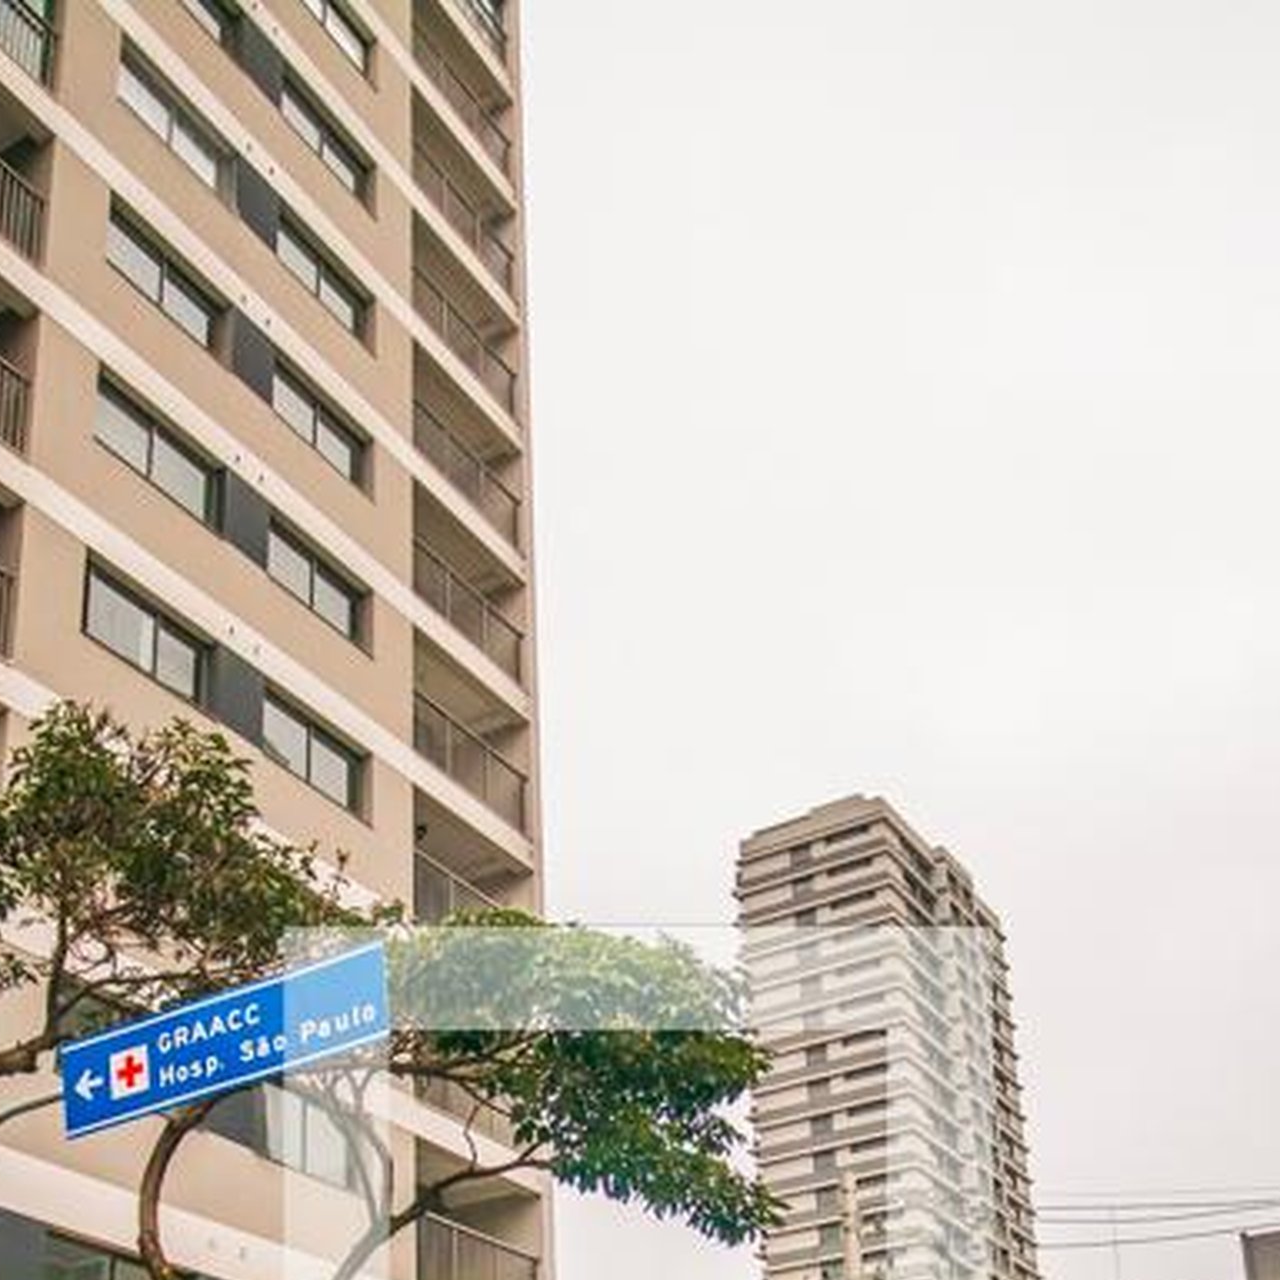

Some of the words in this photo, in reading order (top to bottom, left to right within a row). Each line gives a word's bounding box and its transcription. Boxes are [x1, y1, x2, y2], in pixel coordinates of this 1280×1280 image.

[157, 1003, 260, 1054] GRAACC
[159, 1055, 225, 1088] Hosp.
[239, 1035, 288, 1062] São
[300, 1003, 376, 1042] Paulo
